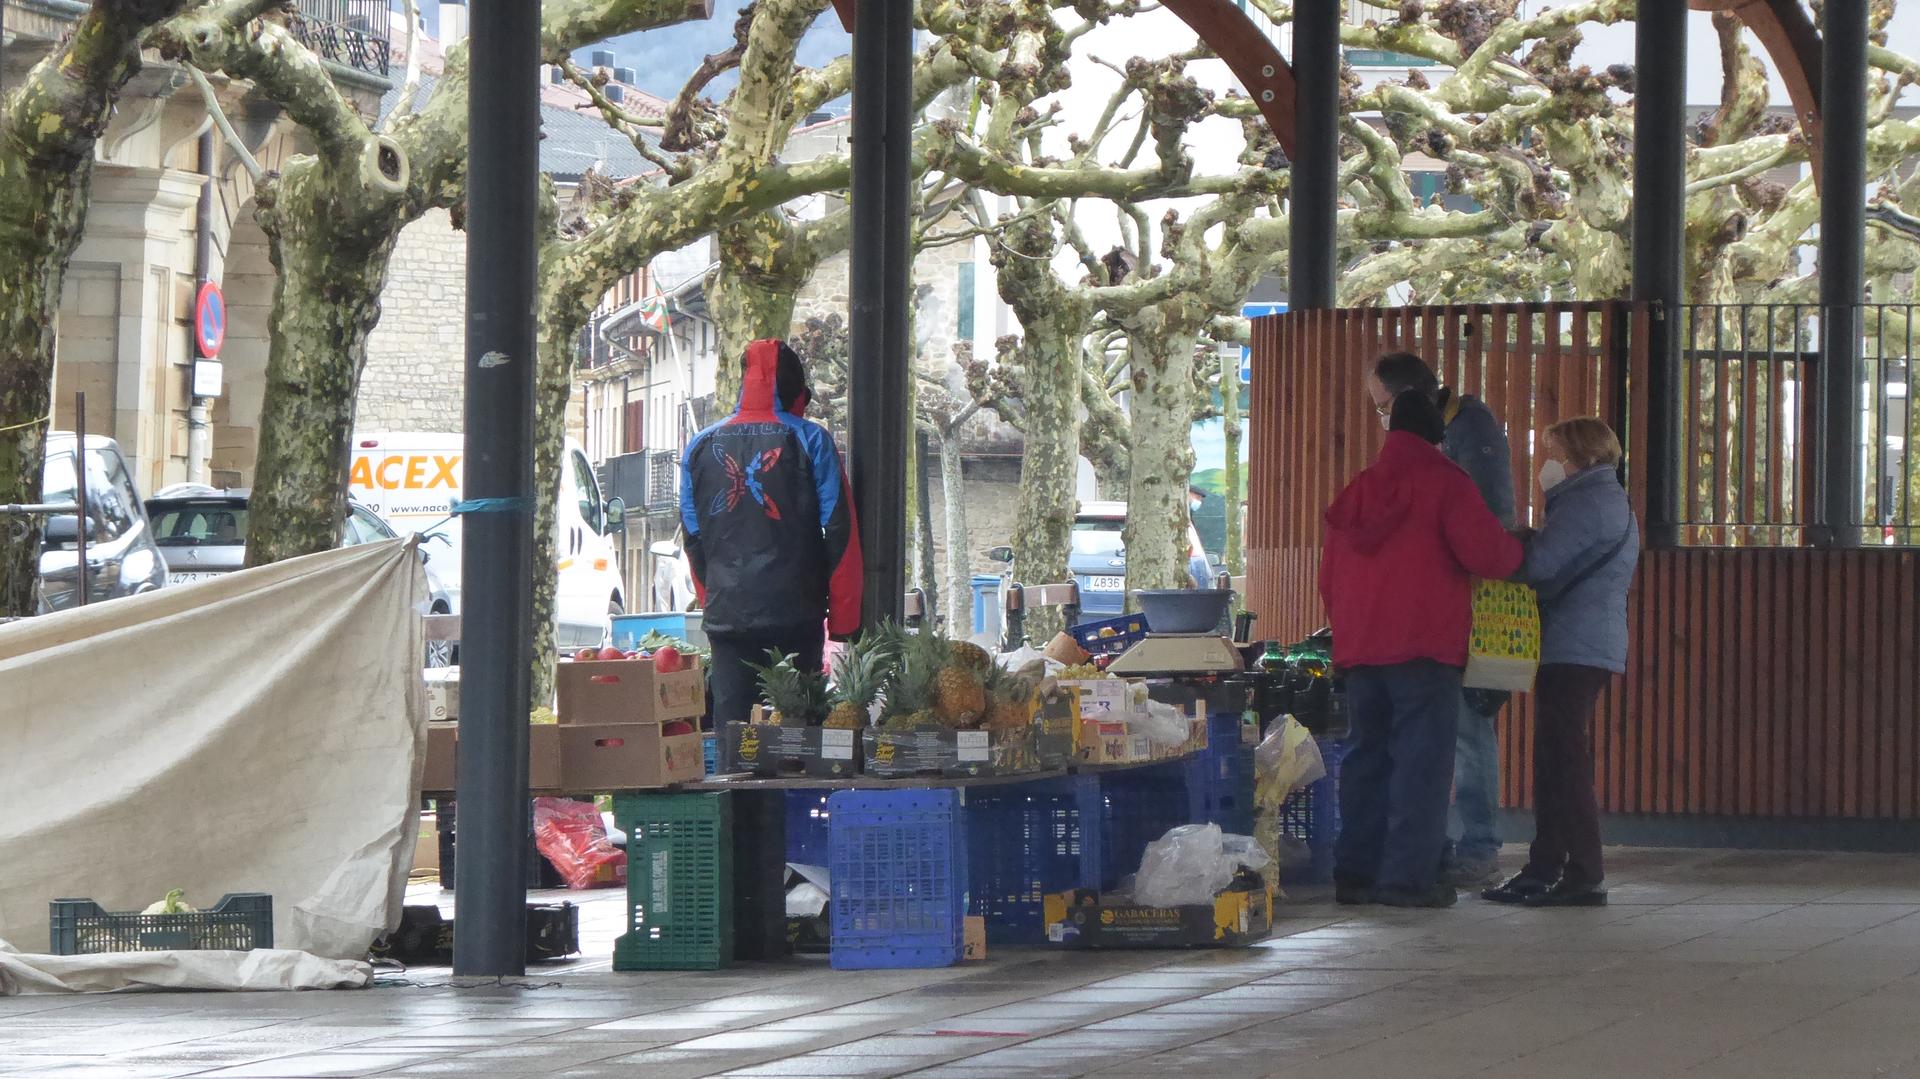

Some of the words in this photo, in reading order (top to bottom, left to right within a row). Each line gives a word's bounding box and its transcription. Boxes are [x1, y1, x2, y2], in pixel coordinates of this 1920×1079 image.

[349, 455, 461, 489] ACEX
[391, 504, 449, 513] www.nace
[1093, 577, 1120, 588] 4836
